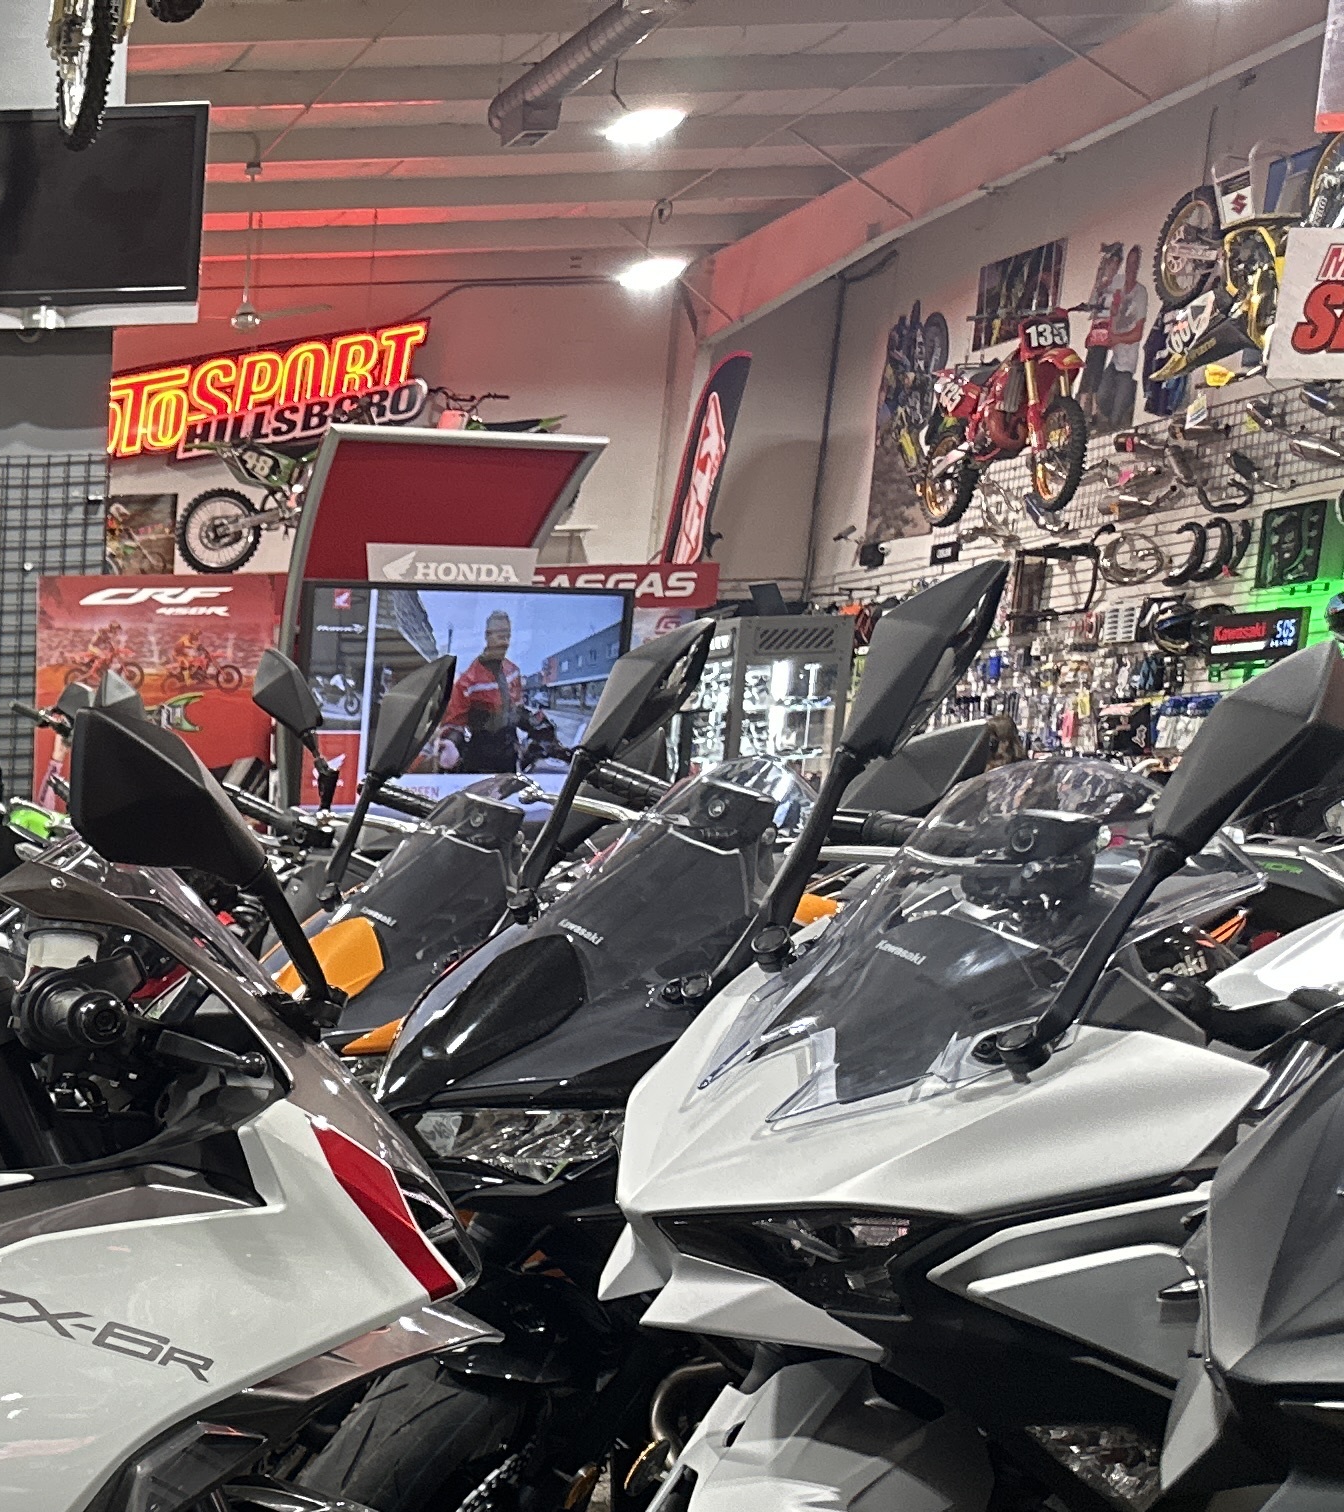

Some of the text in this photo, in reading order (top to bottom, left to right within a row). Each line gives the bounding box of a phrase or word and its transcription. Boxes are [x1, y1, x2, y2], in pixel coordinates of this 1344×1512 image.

[1026, 323, 1069, 349] 135
[414, 561, 519, 584] HONDA
[78, 586, 234, 606] CRF
